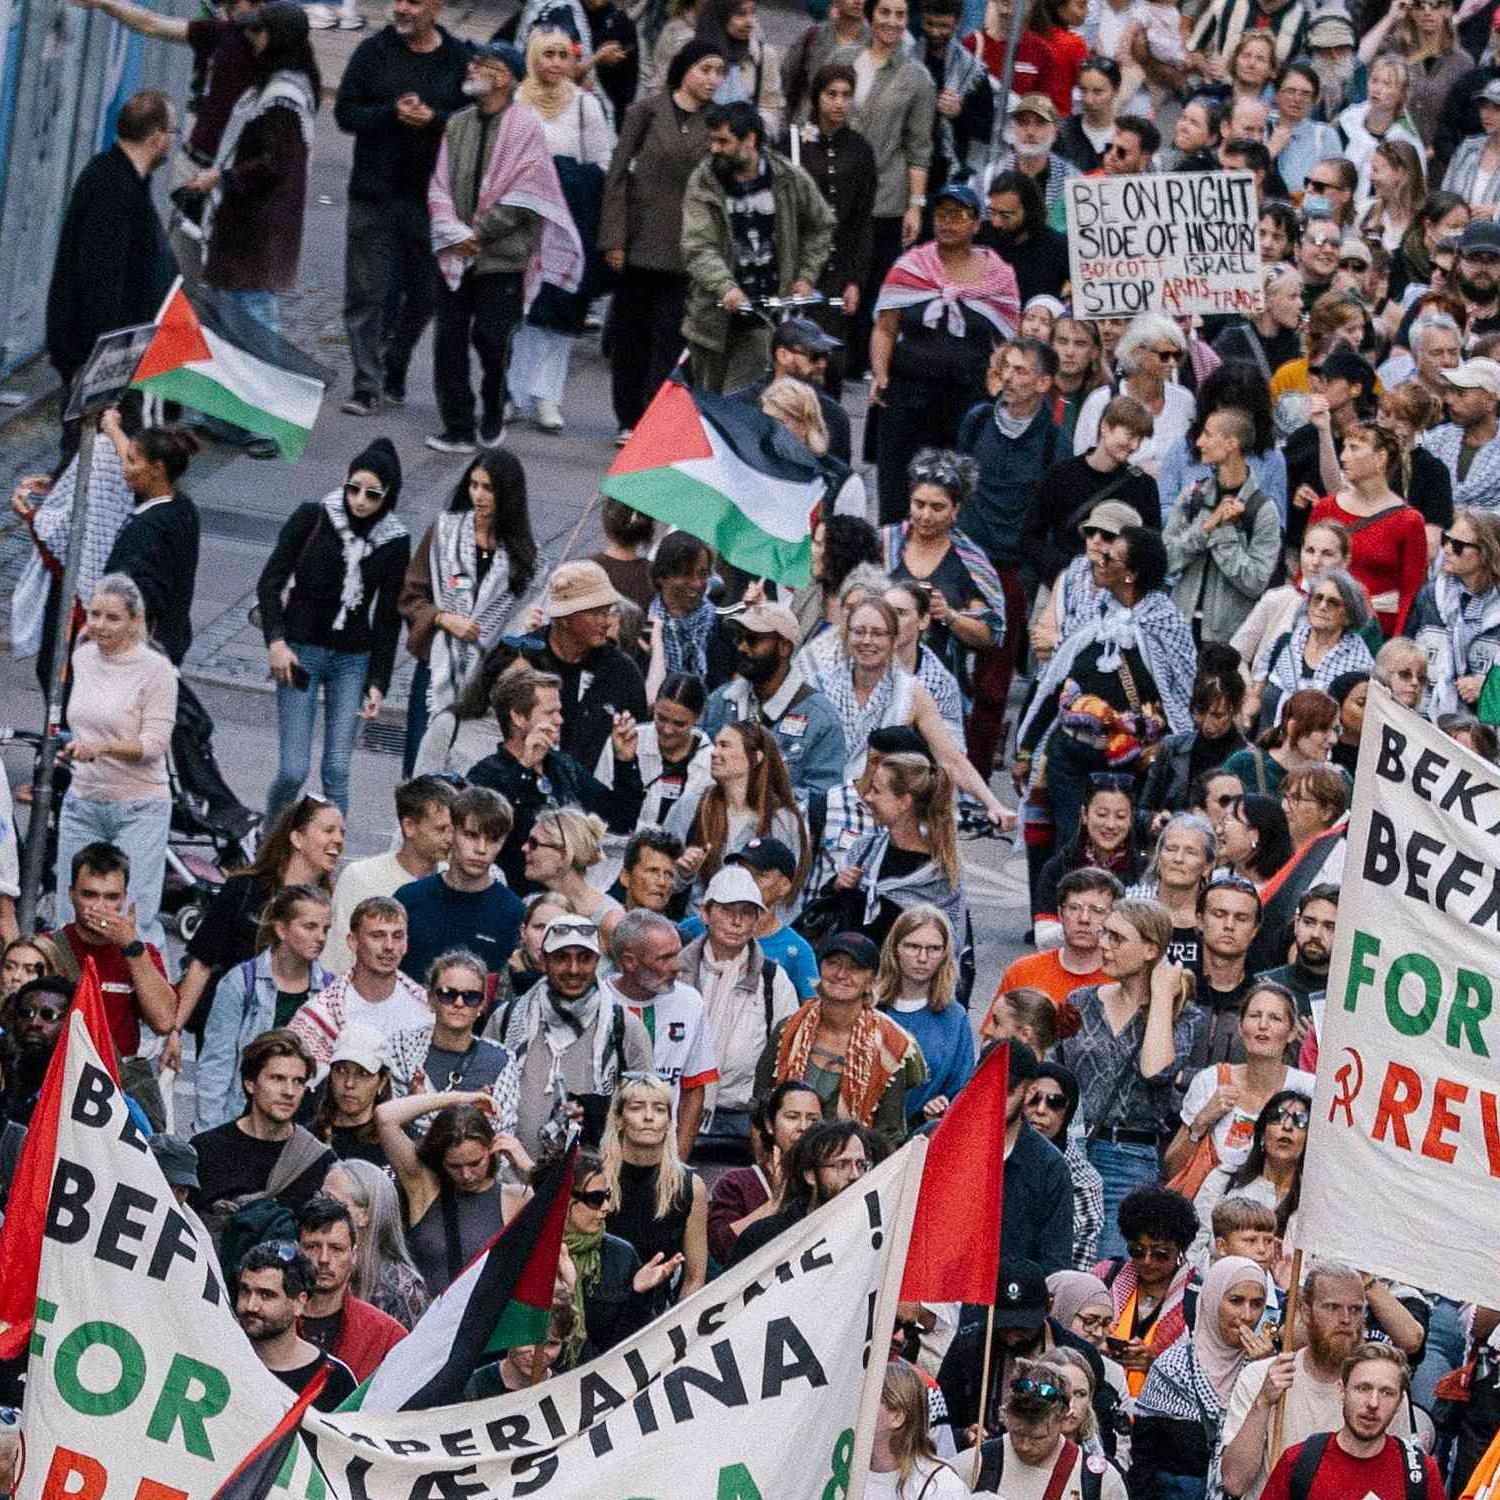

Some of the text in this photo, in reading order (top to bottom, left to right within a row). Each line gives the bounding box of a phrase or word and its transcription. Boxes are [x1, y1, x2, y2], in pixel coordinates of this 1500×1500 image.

[1072, 176, 1253, 227] BE ON RIGHT
[1078, 221, 1256, 260] SIDE OF HISTORY
[1184, 254, 1256, 276] ISRAEL
[1083, 280, 1154, 313] STOP
[1161, 275, 1211, 313] ARMS
[1343, 928, 1491, 1059] FOR
